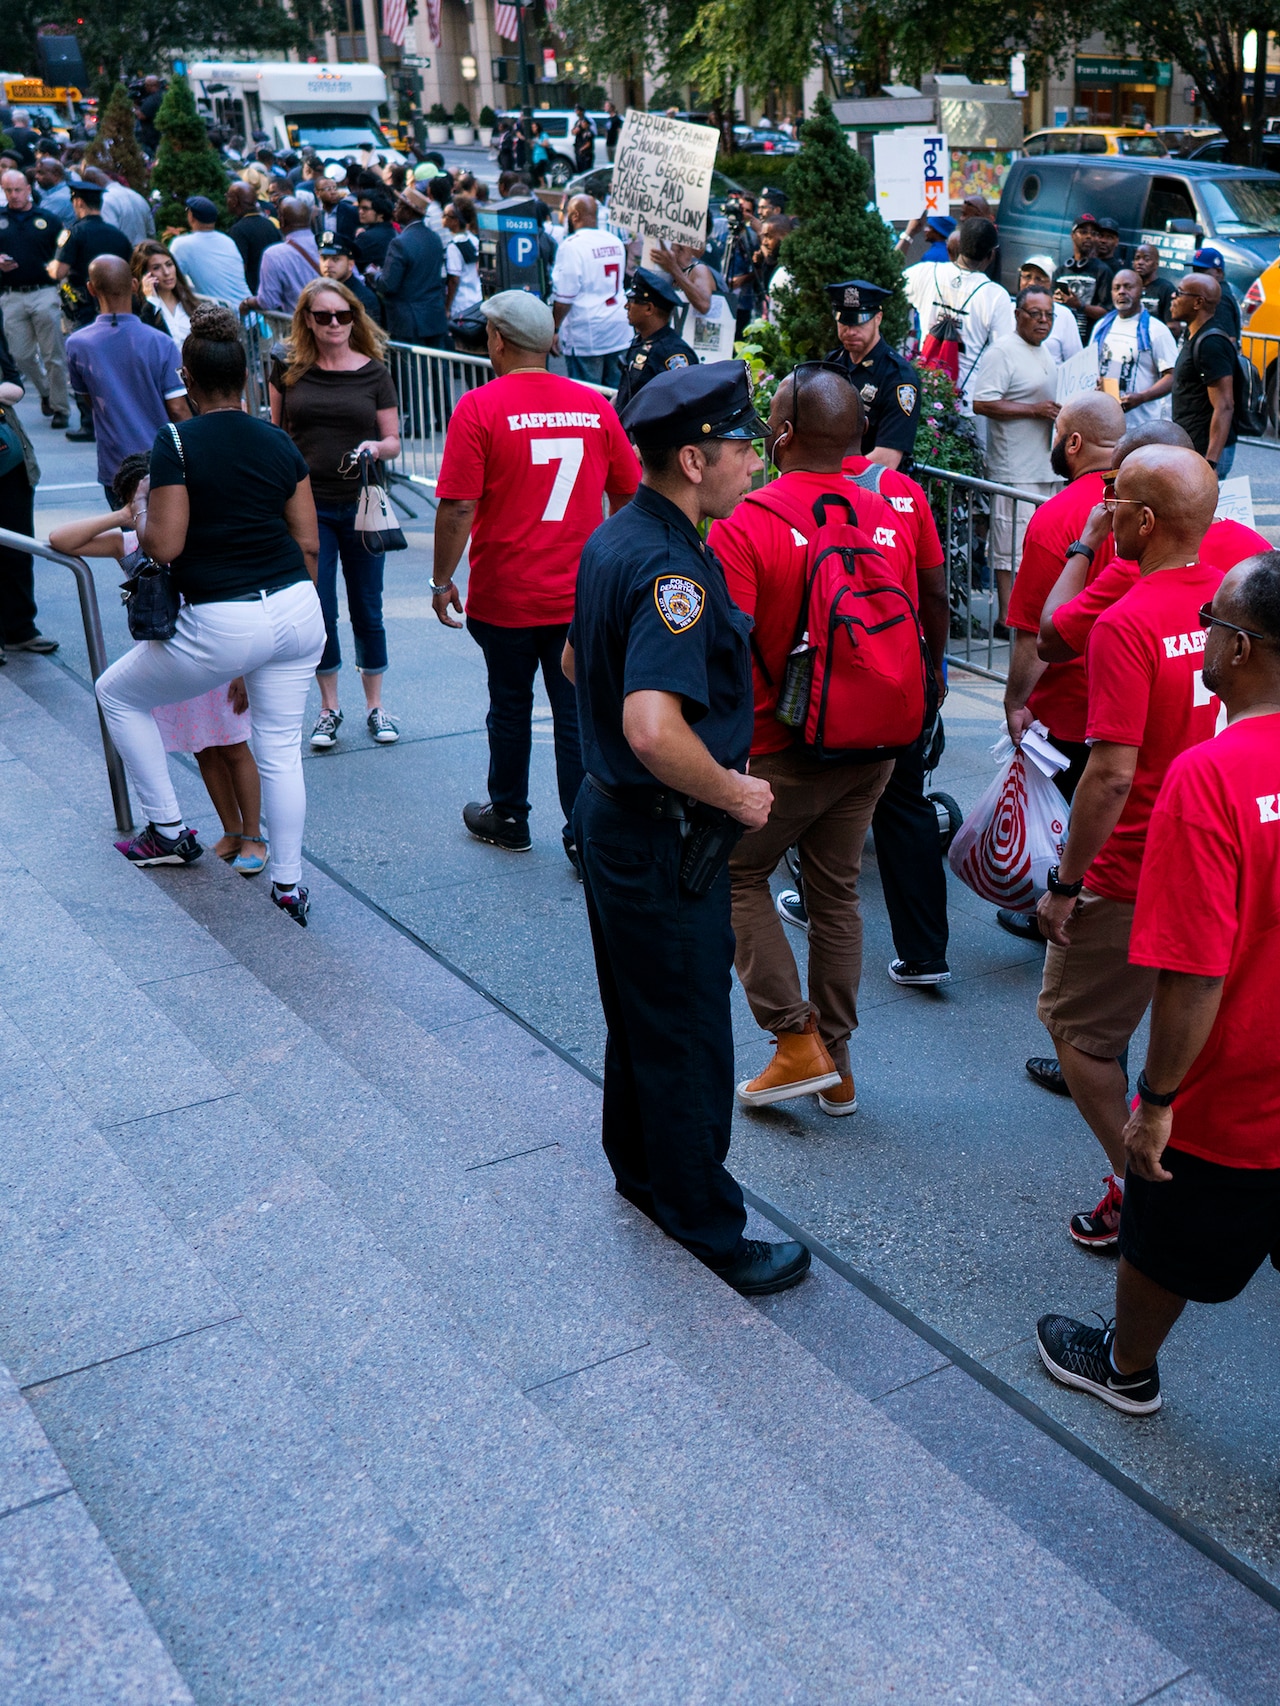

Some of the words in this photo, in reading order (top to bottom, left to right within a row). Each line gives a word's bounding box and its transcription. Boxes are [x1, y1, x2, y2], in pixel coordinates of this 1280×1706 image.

[617, 146, 646, 173] KING
[655, 160, 705, 188] GEORGE
[923, 138, 944, 211] FedEx
[617, 167, 650, 193] TAXES
[659, 180, 684, 204] AND
[506, 219, 533, 230] 106283
[517, 237, 533, 263] P
[604, 264, 619, 307] 7
[508, 413, 601, 431] KAEPERNICK
[531, 438, 585, 521] 7
[660, 584, 701, 601] DEPARTMENT
[670, 579, 695, 590] POLICE
[659, 598, 668, 612] CITY
